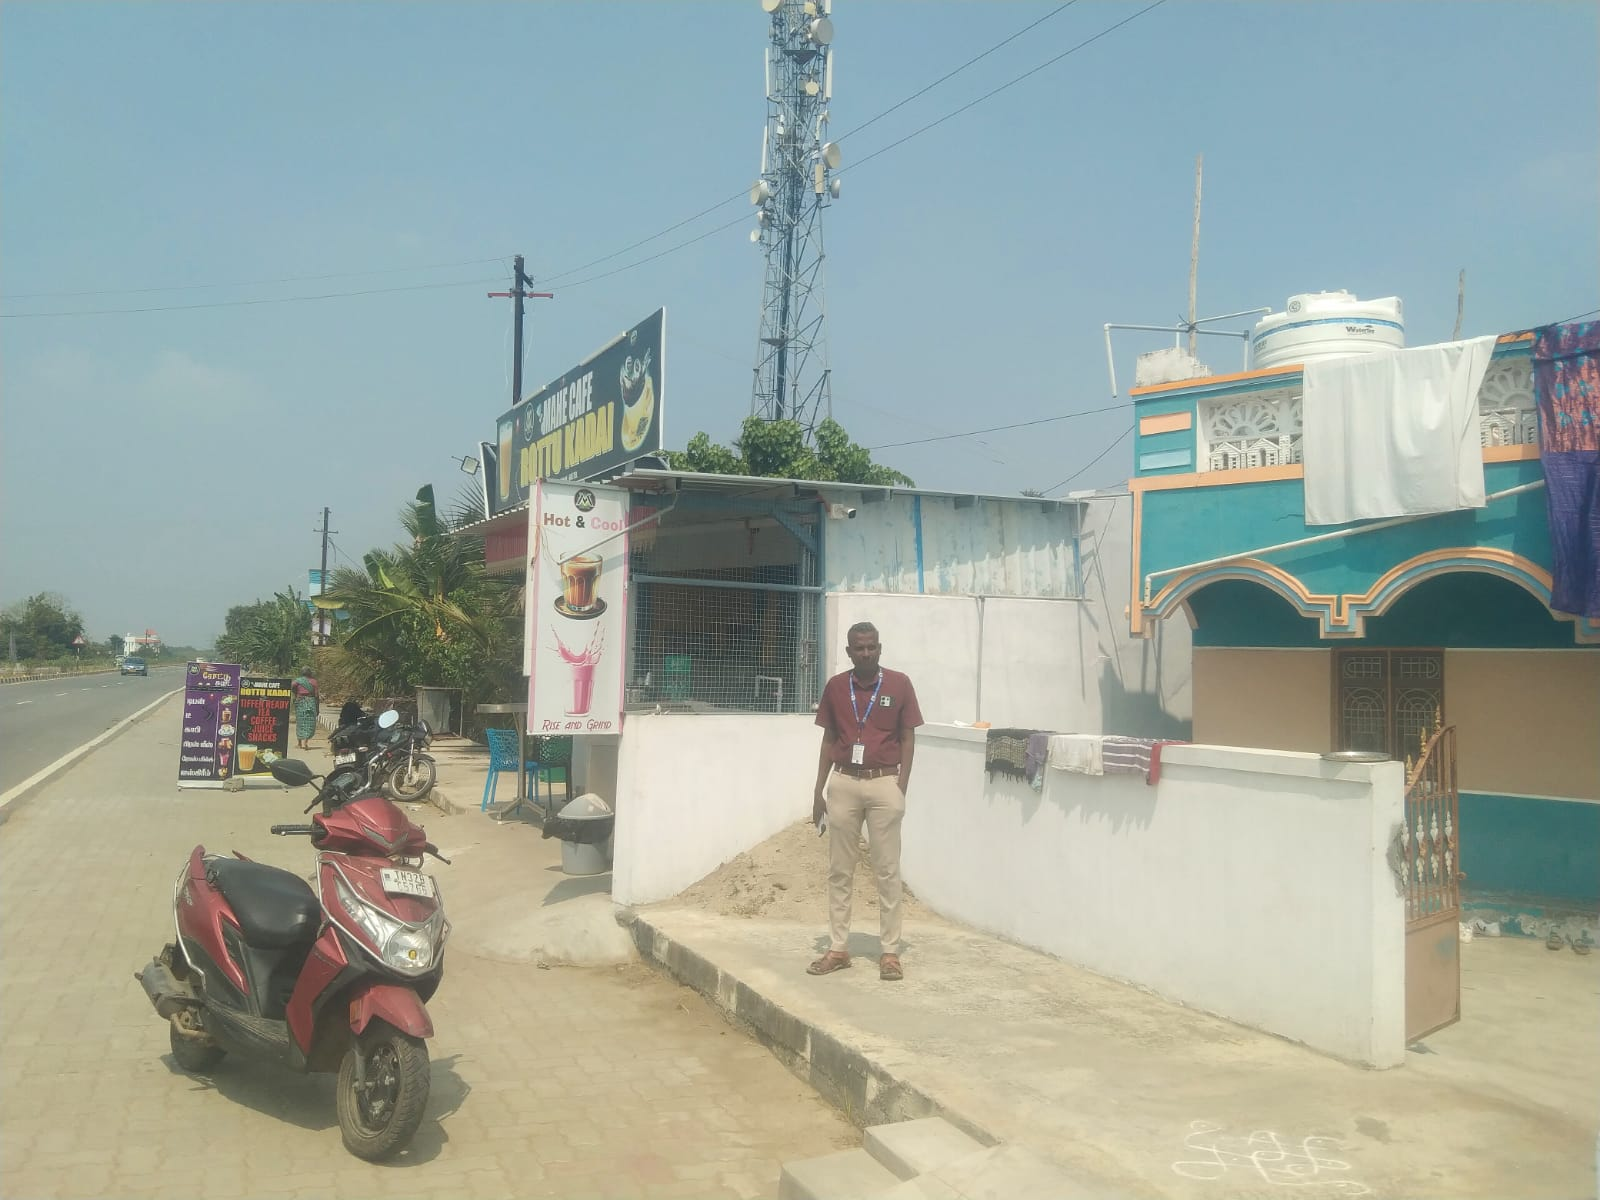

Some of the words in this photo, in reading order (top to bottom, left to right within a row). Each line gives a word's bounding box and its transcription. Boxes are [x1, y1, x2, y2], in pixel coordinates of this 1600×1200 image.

[568, 371, 593, 421] CAFE
[564, 401, 615, 470] KADAI
[544, 513, 571, 528] Hot
[575, 515, 585, 529] &
[591, 516, 623, 532] Cool
[267, 689, 291, 697] KADAI
[265, 700, 289, 709] READY
[258, 708, 270, 717] TEA
[251, 716, 277, 725] COFFEE
[252, 724, 274, 733] JUICE
[247, 732, 278, 742] SNACKS
